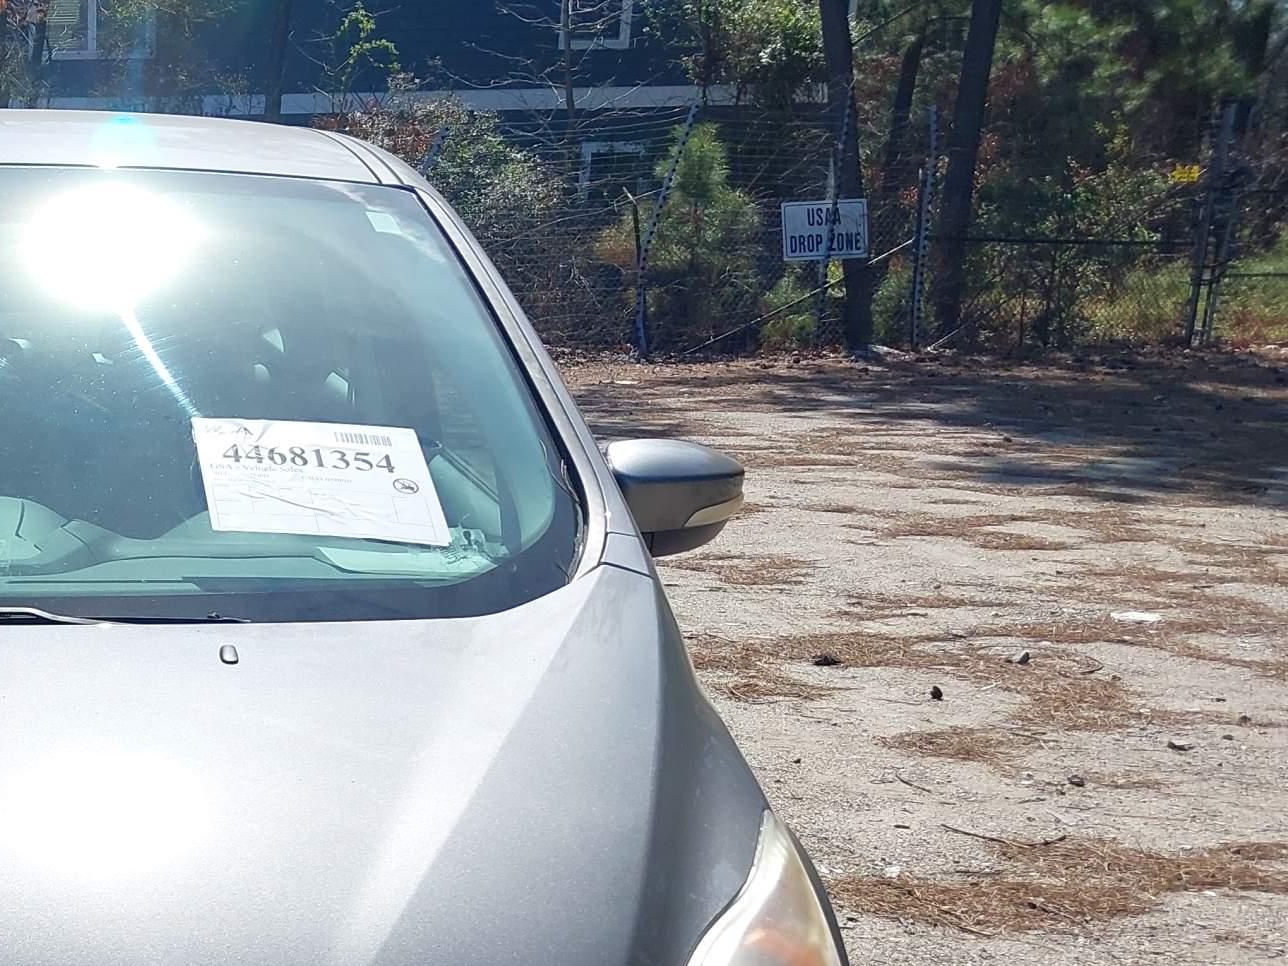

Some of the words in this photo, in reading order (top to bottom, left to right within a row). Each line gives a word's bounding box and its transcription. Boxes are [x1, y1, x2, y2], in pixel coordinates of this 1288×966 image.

[807, 207, 842, 227] USAA
[790, 234, 823, 253] DROP
[827, 232, 862, 252] ZONE
[222, 443, 396, 474] 44681354
